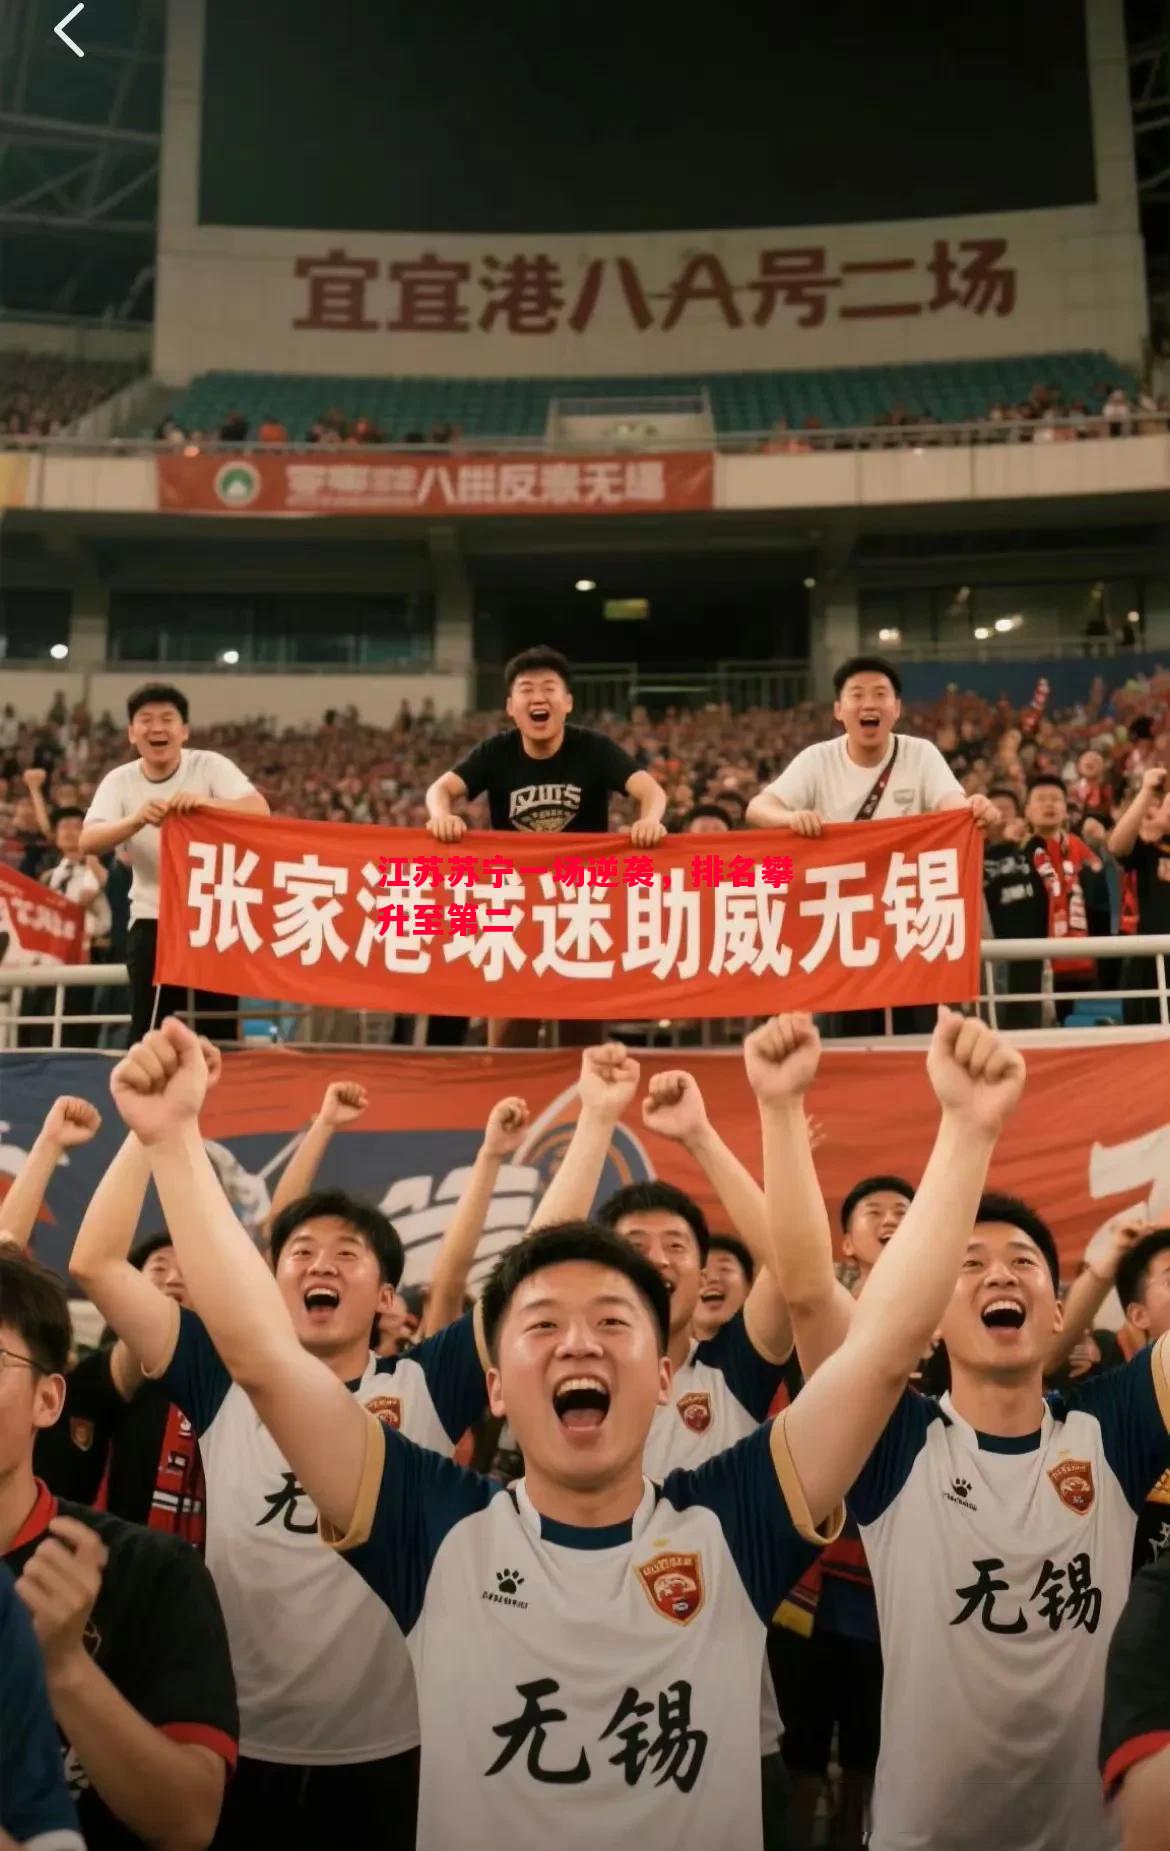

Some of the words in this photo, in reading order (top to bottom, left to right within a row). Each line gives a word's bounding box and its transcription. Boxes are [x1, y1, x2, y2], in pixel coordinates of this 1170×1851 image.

[186, 842, 967, 983] 张家港球迷助威无锡
[256, 1471, 319, 1534] 无
[950, 1552, 1102, 1635] 无锡
[484, 1677, 708, 1793] 无锡
